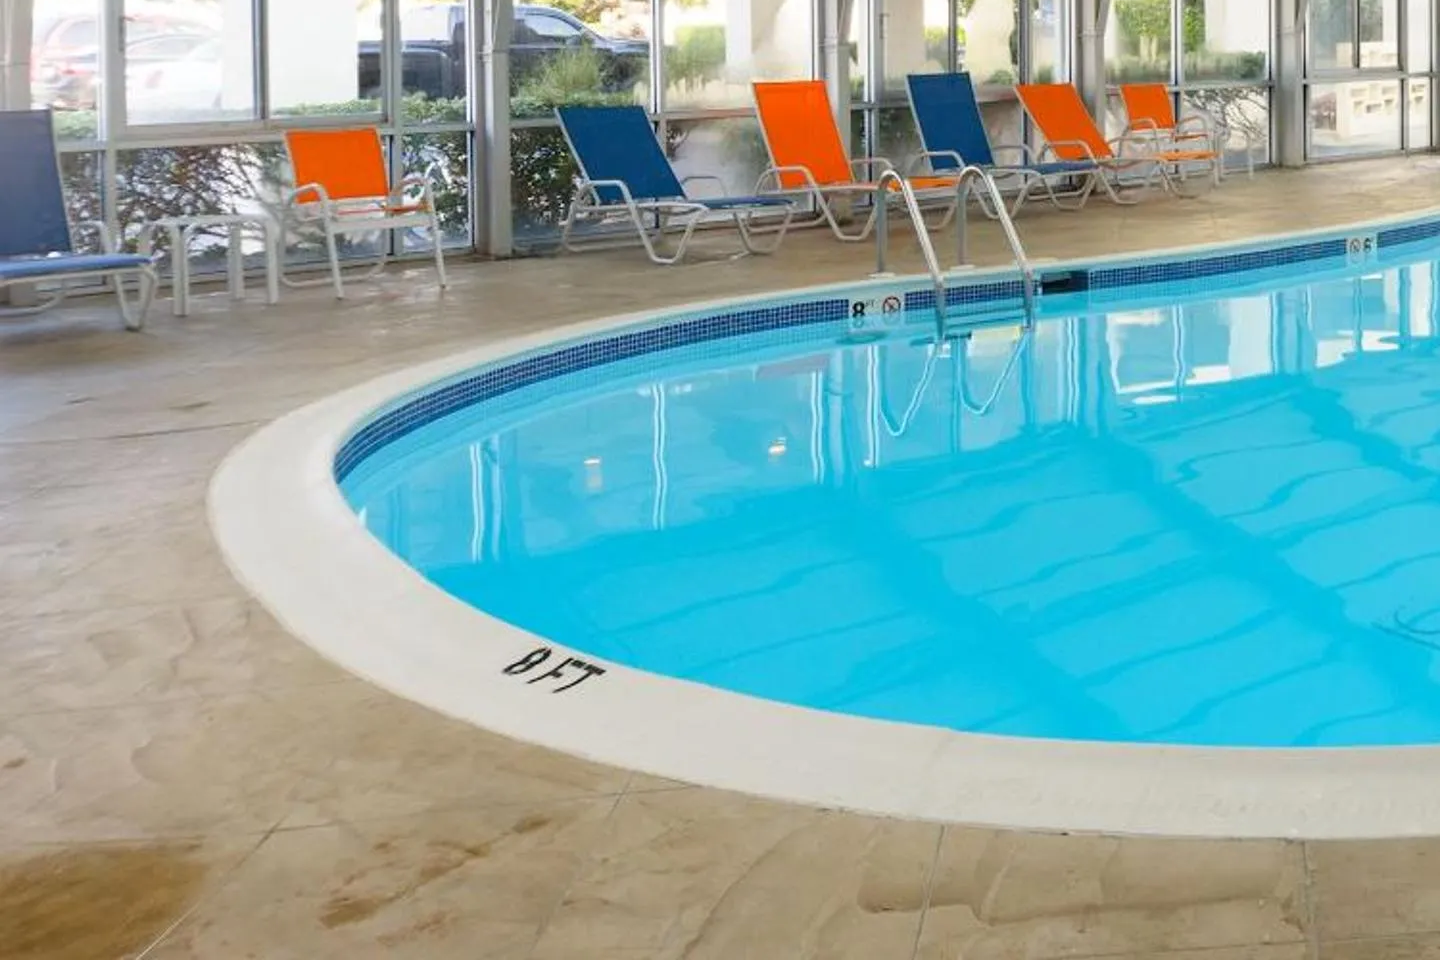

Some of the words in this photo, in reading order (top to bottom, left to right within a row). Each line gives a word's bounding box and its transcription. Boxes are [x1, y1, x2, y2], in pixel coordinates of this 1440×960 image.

[852, 301, 865, 318] 8
[501, 647, 552, 675] 8
[525, 657, 606, 693] FT
